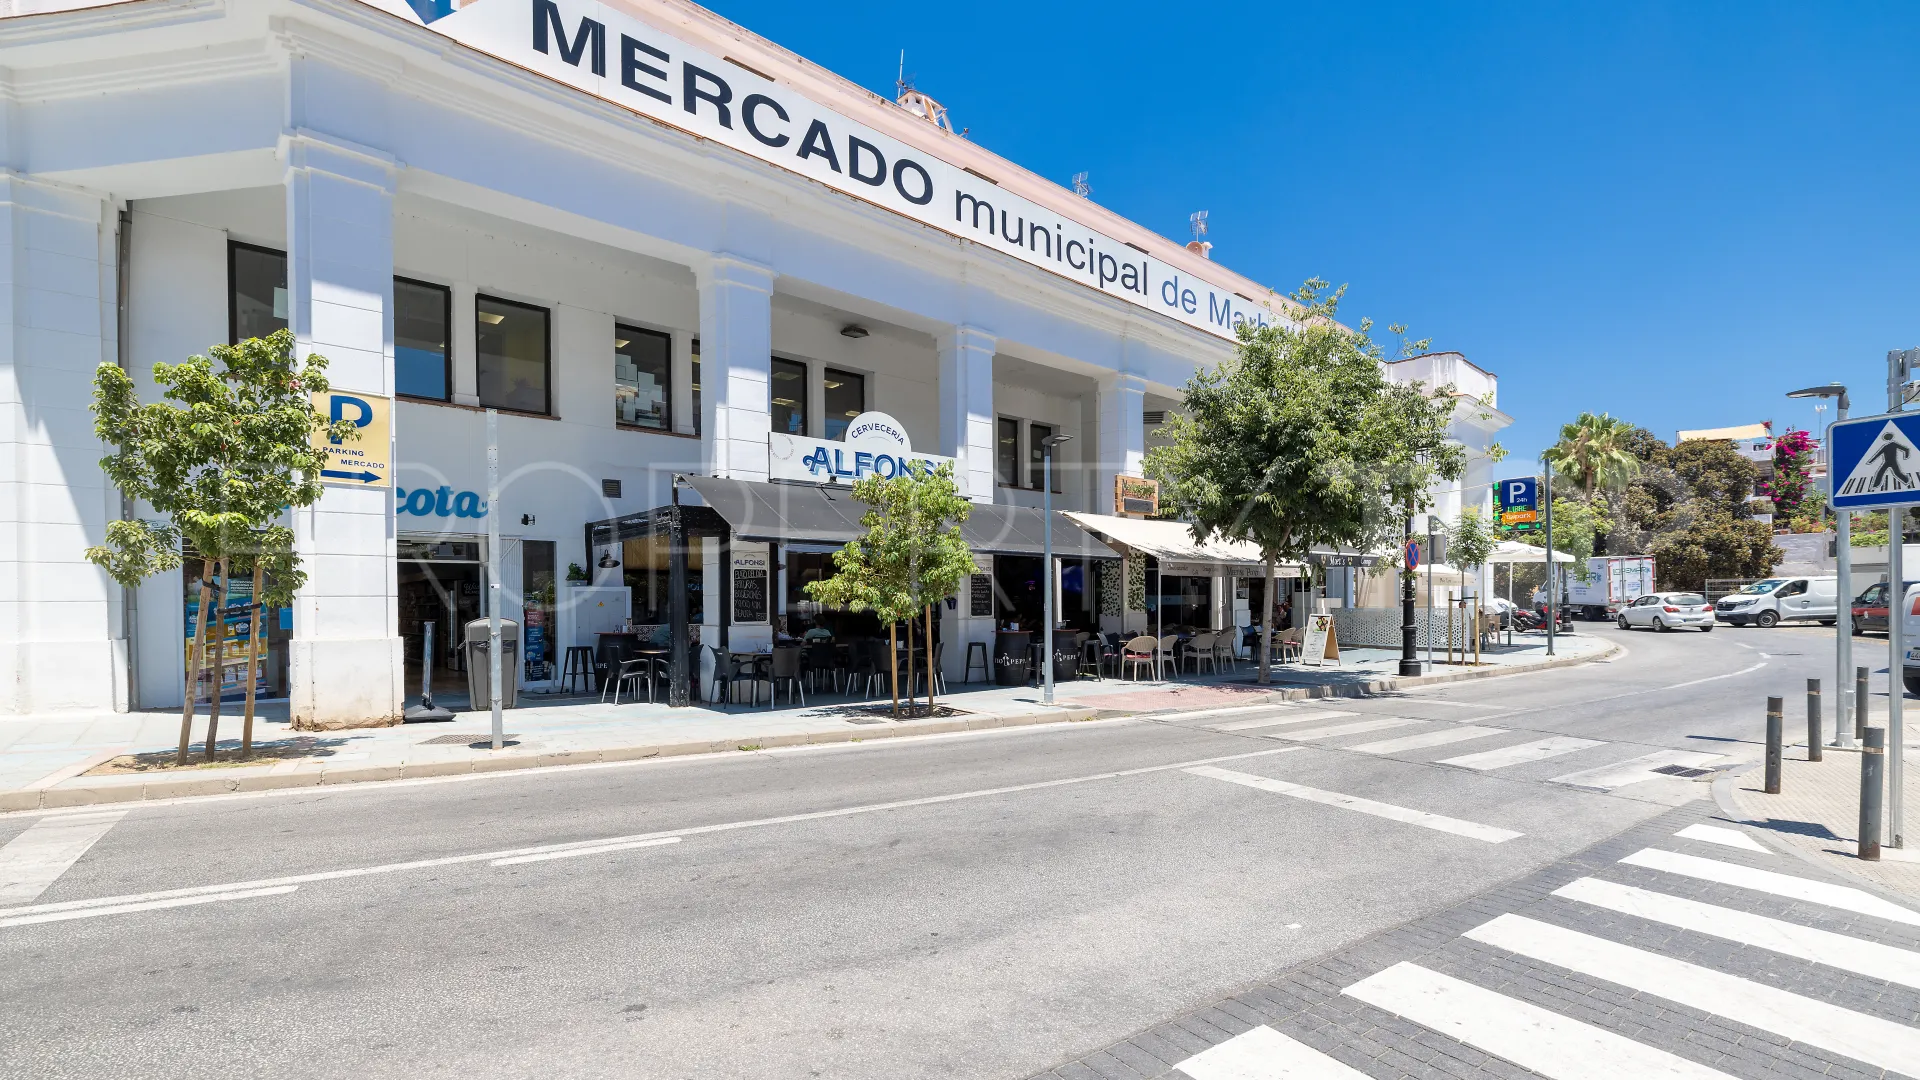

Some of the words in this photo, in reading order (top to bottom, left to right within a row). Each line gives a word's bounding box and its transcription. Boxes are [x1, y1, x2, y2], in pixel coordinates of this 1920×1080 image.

[532, 0, 934, 206] MERCADO
[955, 189, 1149, 297] municipal
[1161, 275, 1197, 315] de
[330, 395, 373, 445] P
[322, 446, 365, 457] PARKING
[340, 459, 385, 469] MERCADO
[1509, 482, 1527, 504] P
[1507, 505, 1527, 513] LIBRE
